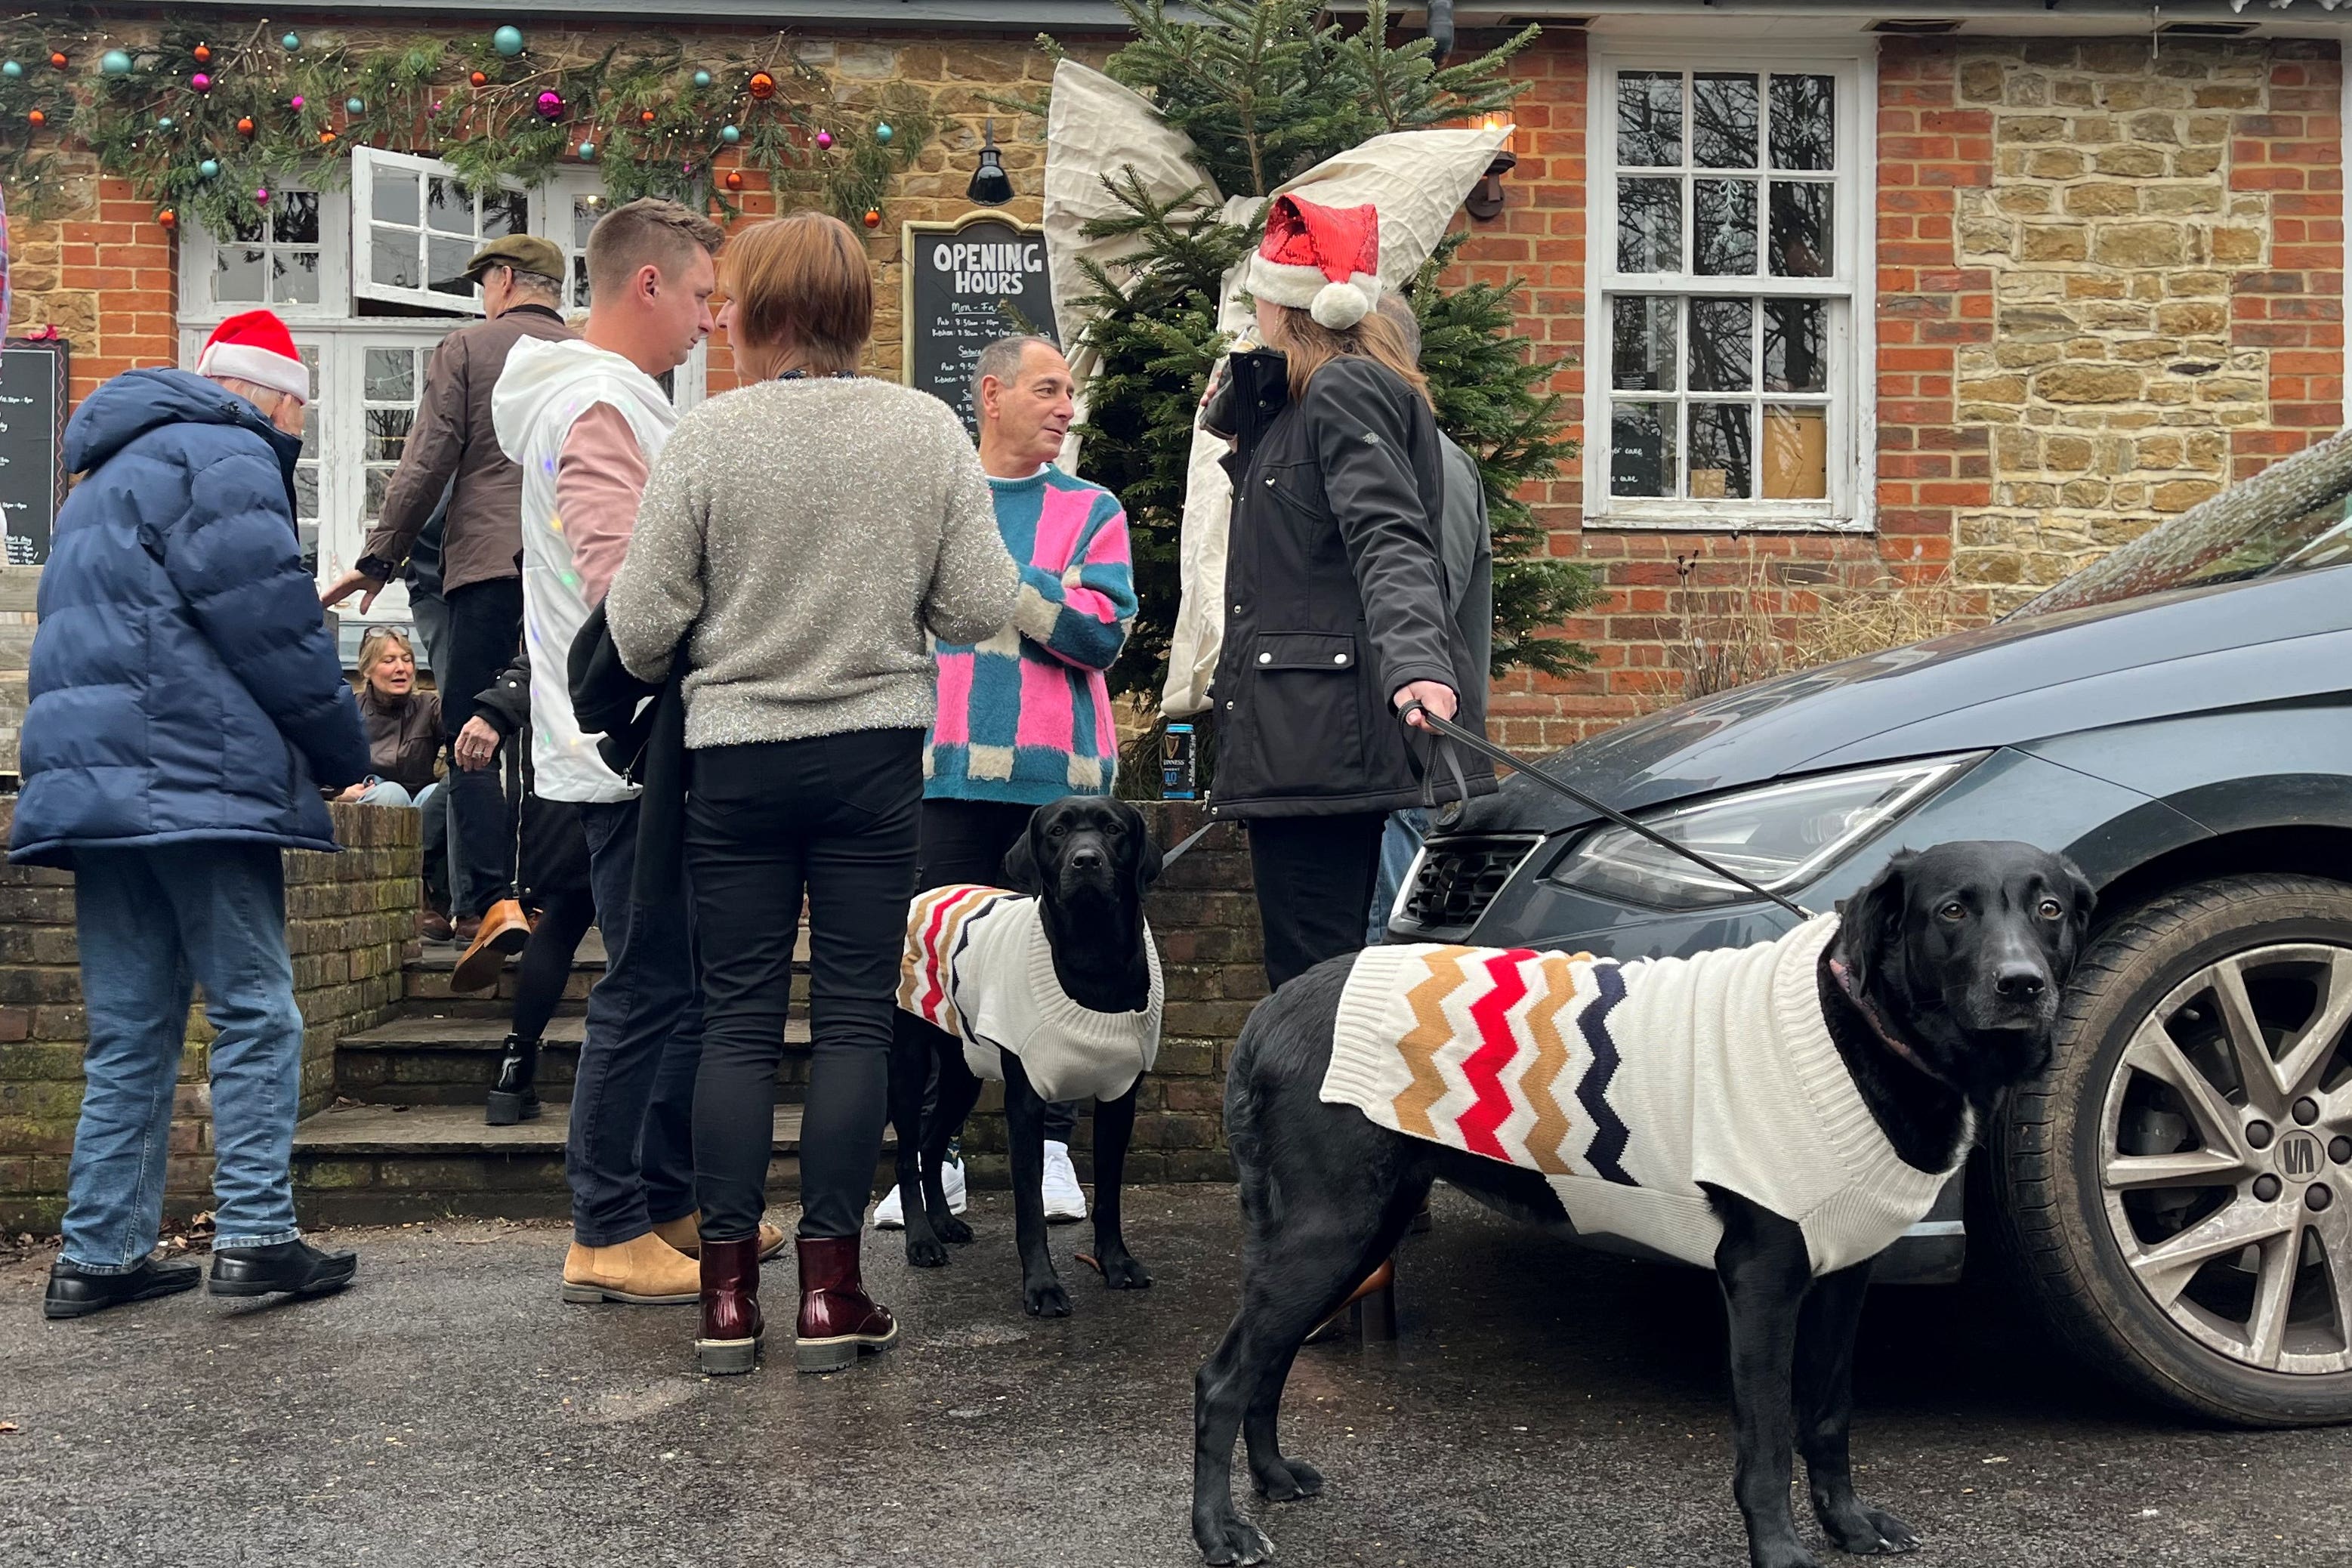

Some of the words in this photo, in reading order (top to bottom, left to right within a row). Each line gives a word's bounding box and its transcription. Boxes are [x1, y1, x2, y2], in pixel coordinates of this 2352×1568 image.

[933, 243, 1042, 273] OPENING
[955, 271, 1023, 295] HOURS
[952, 302, 972, 313] Mon
[986, 319, 999, 327] 10pm
[985, 329, 997, 338] 9pm
[959, 363, 977, 371] 9:30
